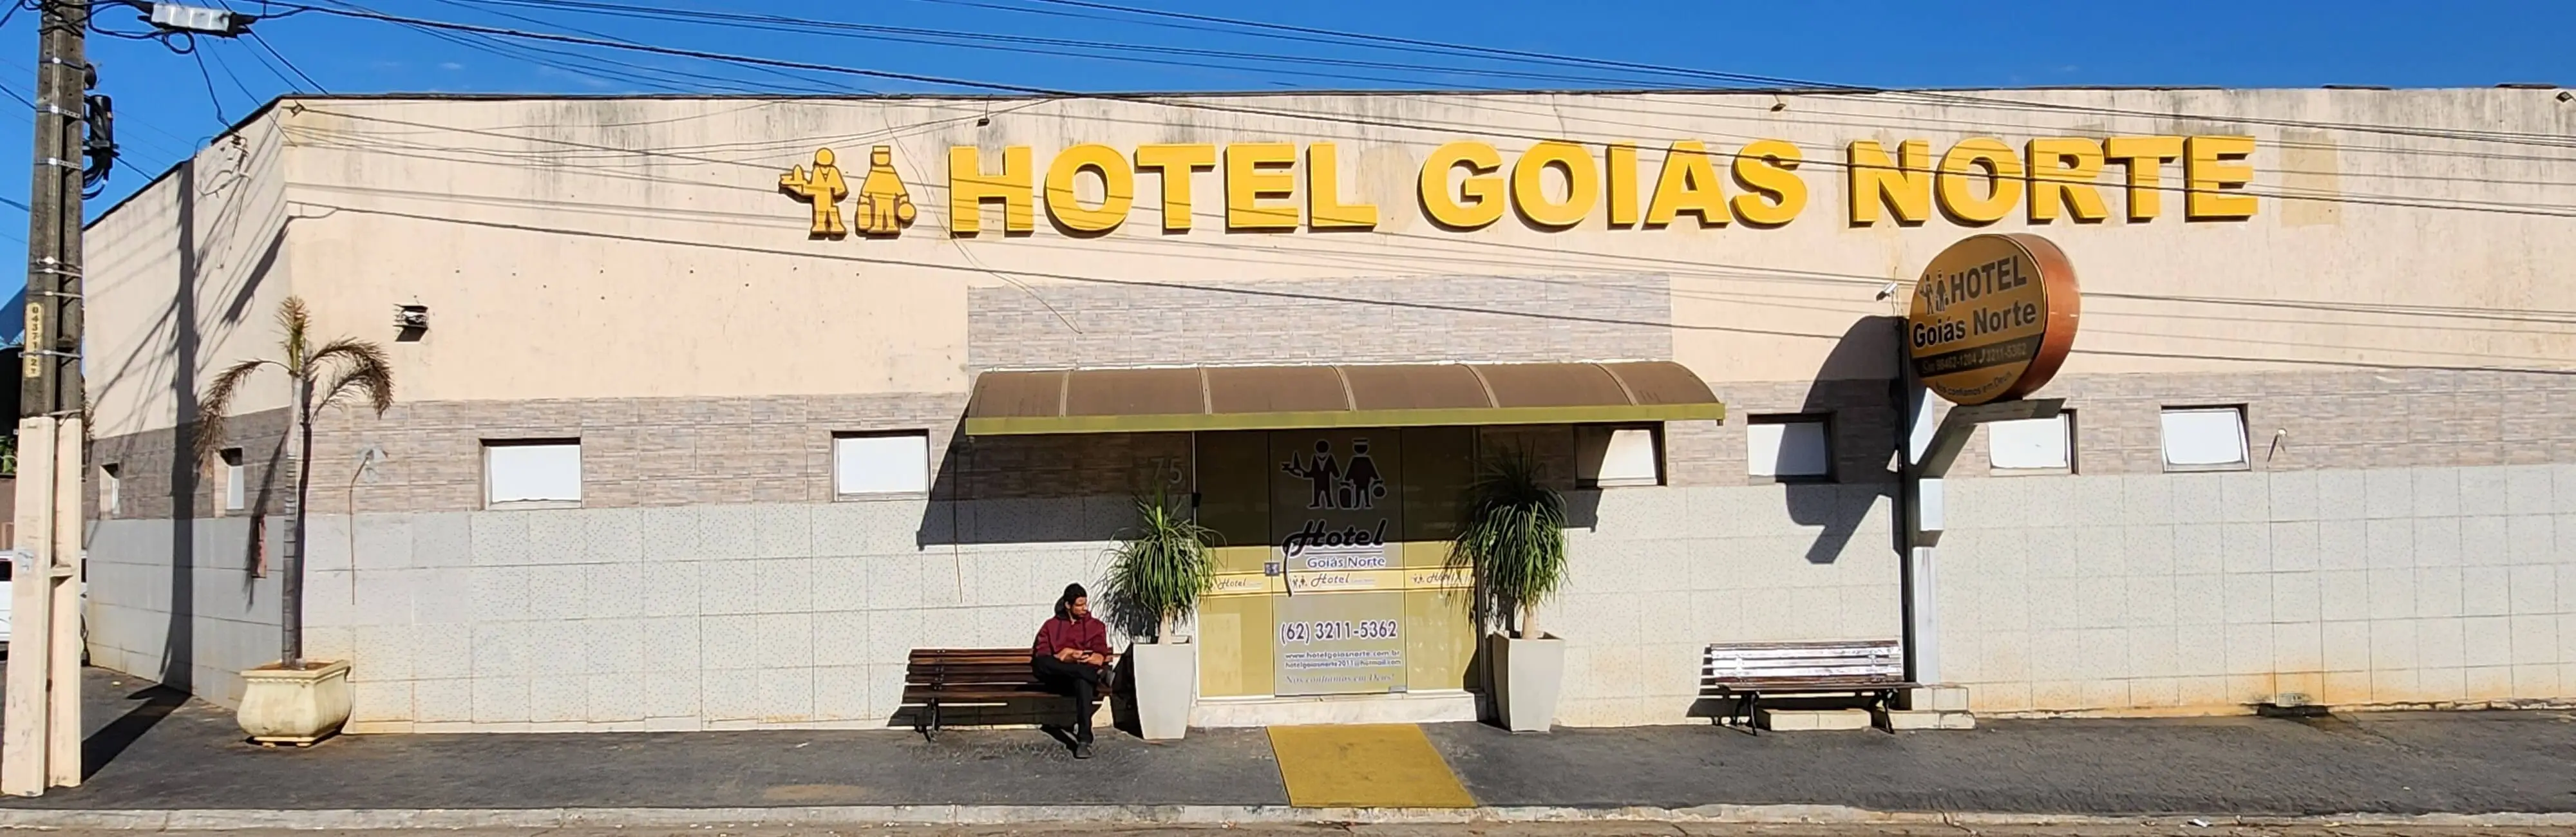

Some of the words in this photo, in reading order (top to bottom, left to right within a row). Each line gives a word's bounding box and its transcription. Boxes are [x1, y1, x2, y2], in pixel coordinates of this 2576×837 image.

[949, 143, 1378, 239] HOTEL
[1417, 139, 1807, 232] GOIAS
[1848, 136, 2259, 229] NORTE
[1950, 255, 2027, 304] HOTEL
[1913, 316, 1965, 348] Goiás
[1973, 300, 2036, 335] Norte
[1307, 556, 1344, 569] Goiás
[1348, 556, 1385, 568] Norte
[1217, 578, 1247, 590] Hotel
[1311, 573, 1350, 587] Hotel
[1281, 622, 1310, 644] (62)
[1316, 621, 1397, 639] 3211-5362
